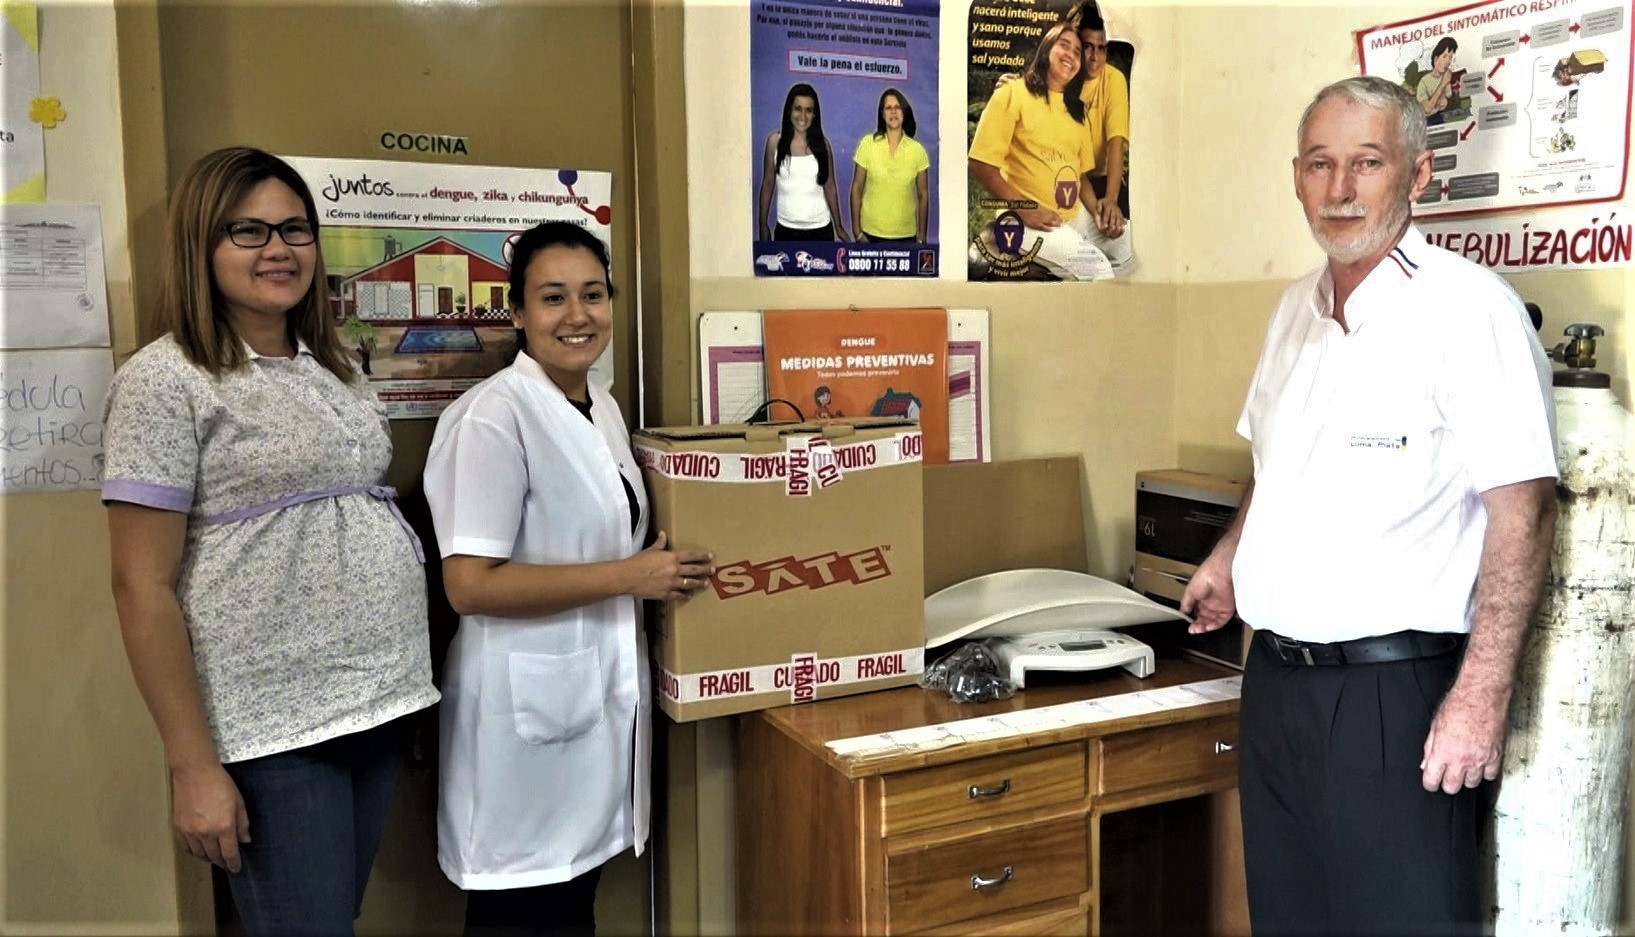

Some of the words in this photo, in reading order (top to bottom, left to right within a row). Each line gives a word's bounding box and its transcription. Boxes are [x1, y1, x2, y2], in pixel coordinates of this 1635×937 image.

[973, 6, 1006, 17] nacerá
[1007, 7, 1059, 23] inteligente
[971, 22, 979, 34] y
[980, 23, 1004, 33] sano
[1005, 25, 1043, 37] porque
[1371, 29, 1422, 50] MANEJO
[1424, 24, 1445, 39] DEL
[1447, 3, 1527, 34] SINTOMÁTICO
[972, 38, 1011, 50] usamos
[797, 55, 817, 67] Vale
[820, 57, 828, 68] la
[831, 60, 852, 71] pena
[854, 61, 863, 71] el
[864, 62, 903, 74] esfuerzo.
[972, 52, 988, 64] sal
[987, 54, 1025, 67] yodada
[381, 132, 468, 155] COCINA
[322, 173, 394, 203] juntos
[429, 186, 478, 203] dengue,
[483, 189, 508, 201] zika
[511, 195, 516, 203] y
[518, 191, 589, 207] chikungunya
[1062, 187, 1073, 206] Y
[326, 209, 360, 219] ¿Cómo
[363, 211, 412, 221] identificar
[414, 213, 420, 223] y
[422, 213, 460, 222] eliminar
[463, 215, 506, 224] criaderos
[508, 217, 520, 225] en
[1003, 231, 1015, 248] Y
[848, 258, 872, 271] 0800
[873, 258, 884, 271] 11
[886, 258, 898, 271] 55
[840, 337, 876, 347] DENGUE
[780, 356, 843, 371] MEDIDAS
[846, 353, 935, 369] PREVENTIVAS
